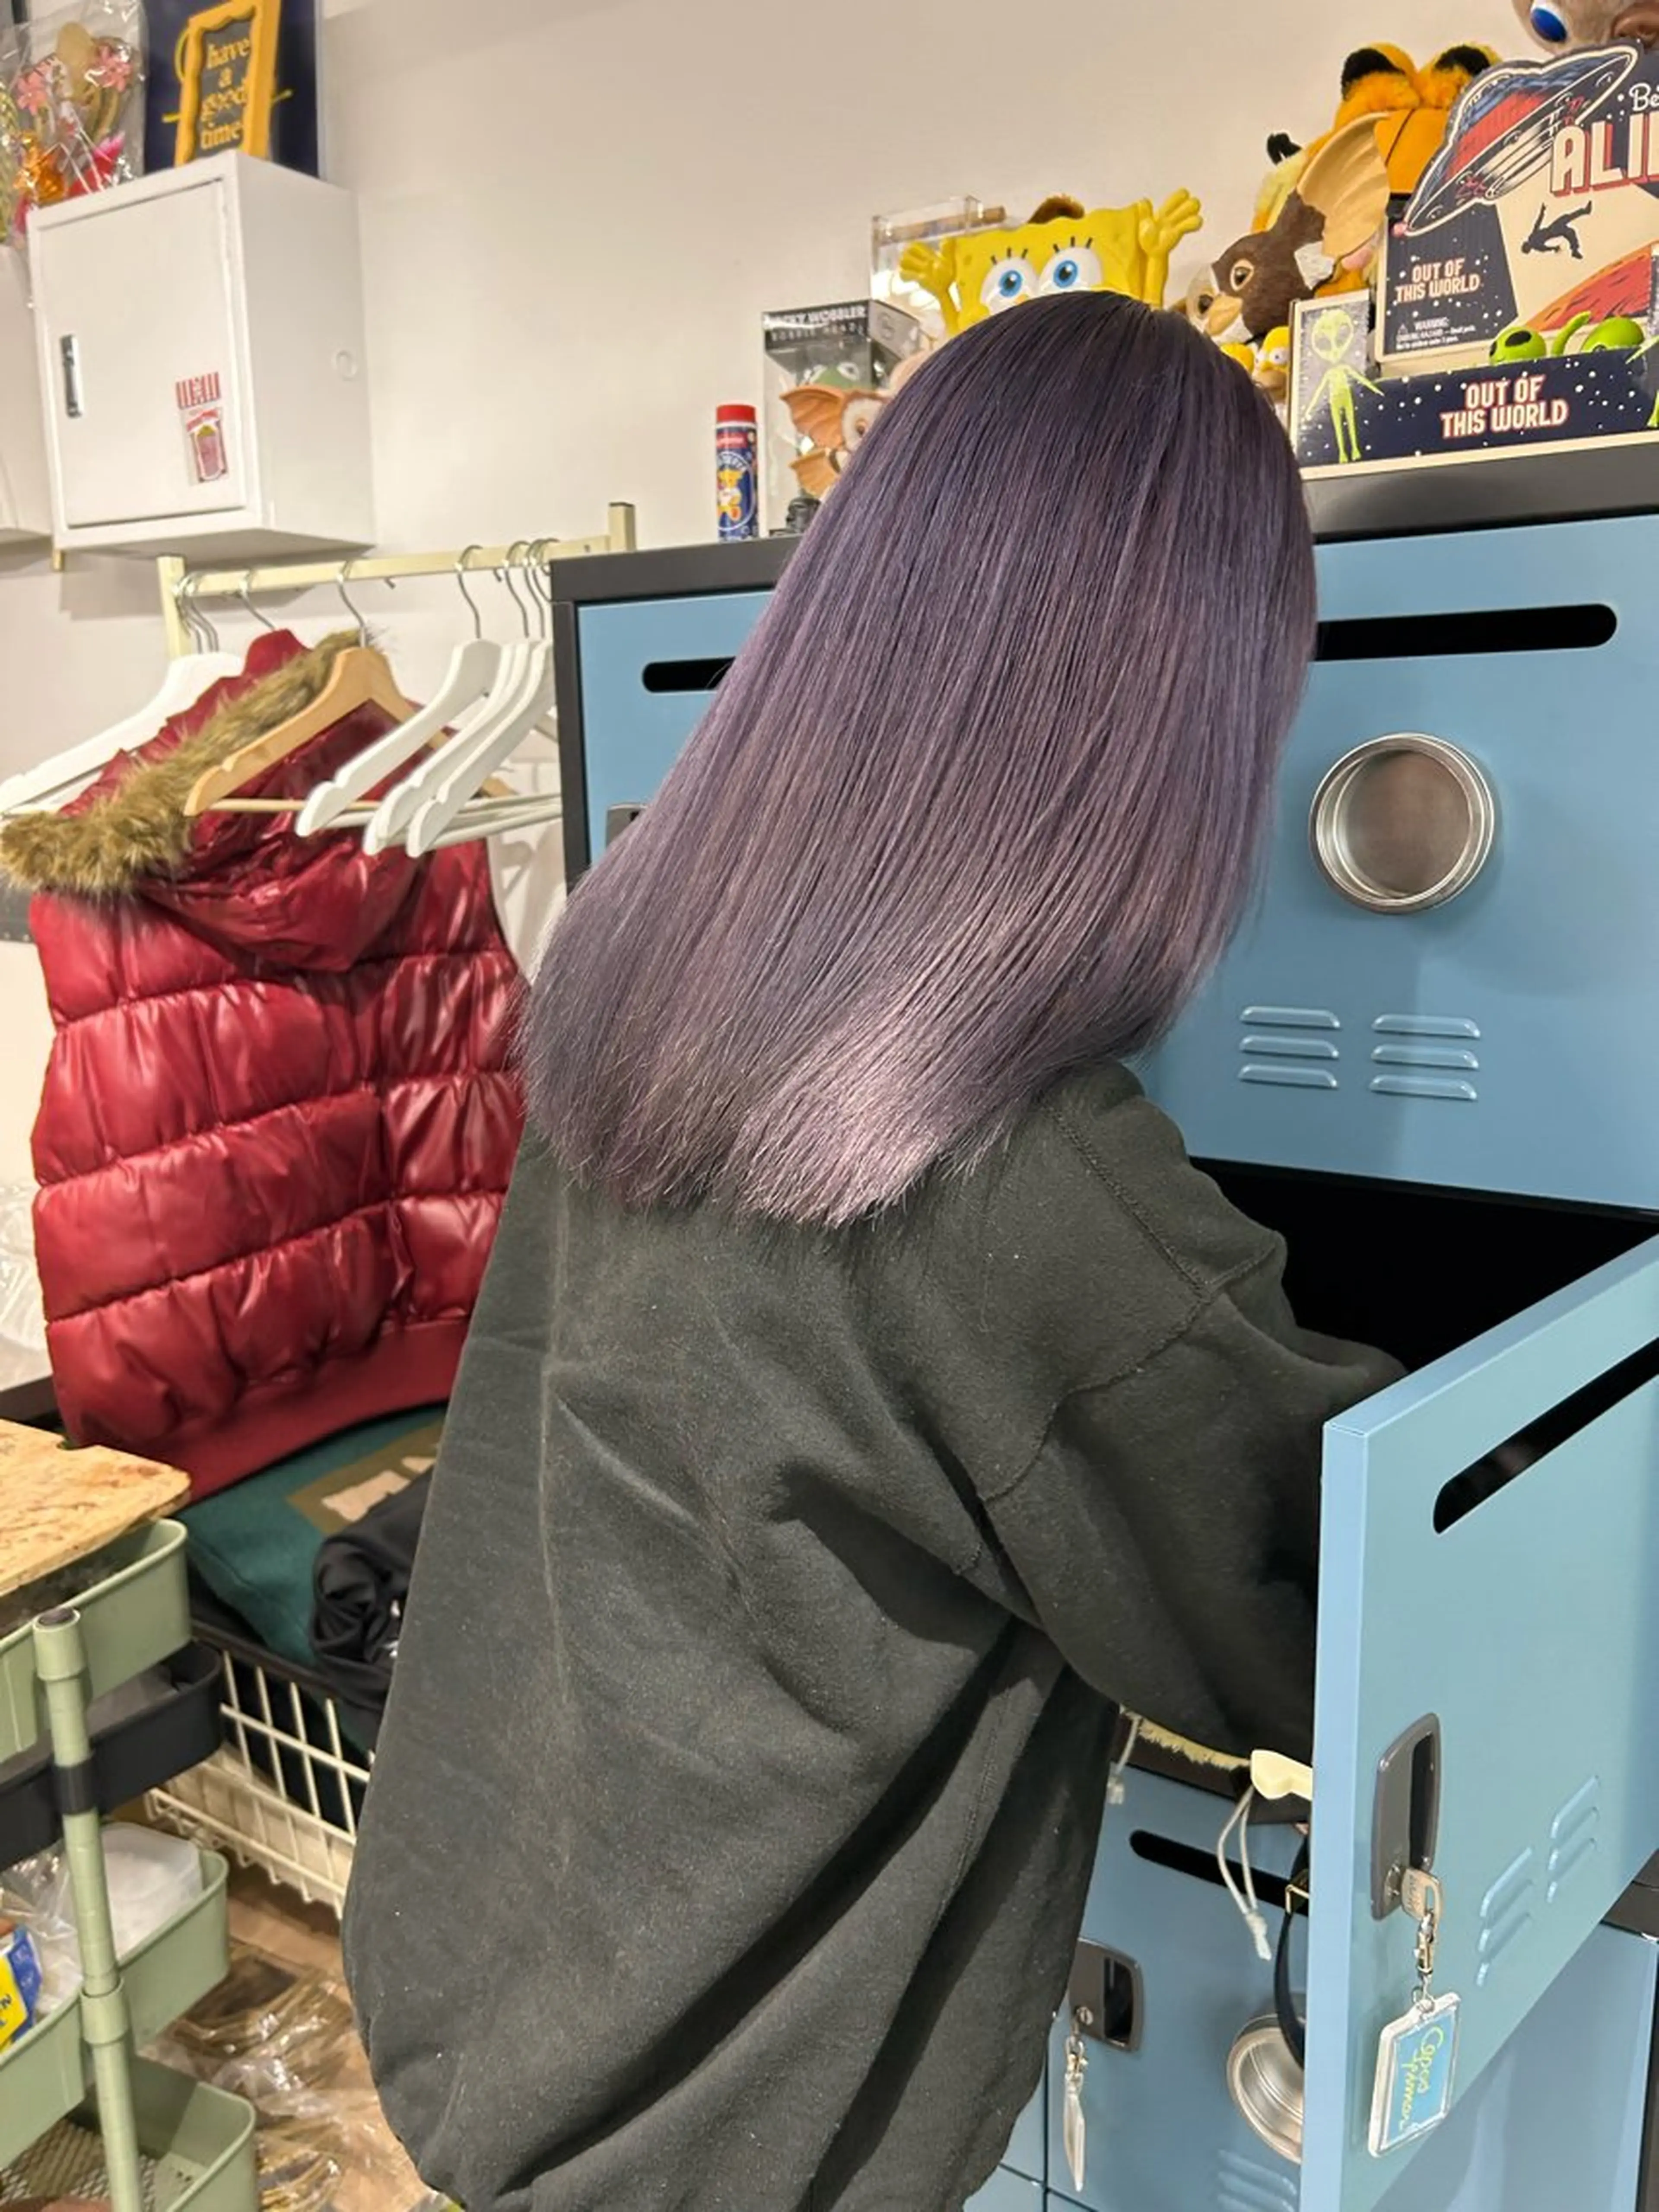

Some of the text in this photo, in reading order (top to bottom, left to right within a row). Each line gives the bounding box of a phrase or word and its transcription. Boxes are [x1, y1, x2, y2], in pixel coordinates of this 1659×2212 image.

[207, 38, 250, 69] have
[219, 67, 232, 88] a
[201, 78, 248, 122] good
[1412, 257, 1465, 283] OUT OF
[1395, 273, 1481, 303] THIS WORLD
[1466, 374, 1546, 409] OUT OF
[1439, 398, 1570, 439] THIS WORLD
